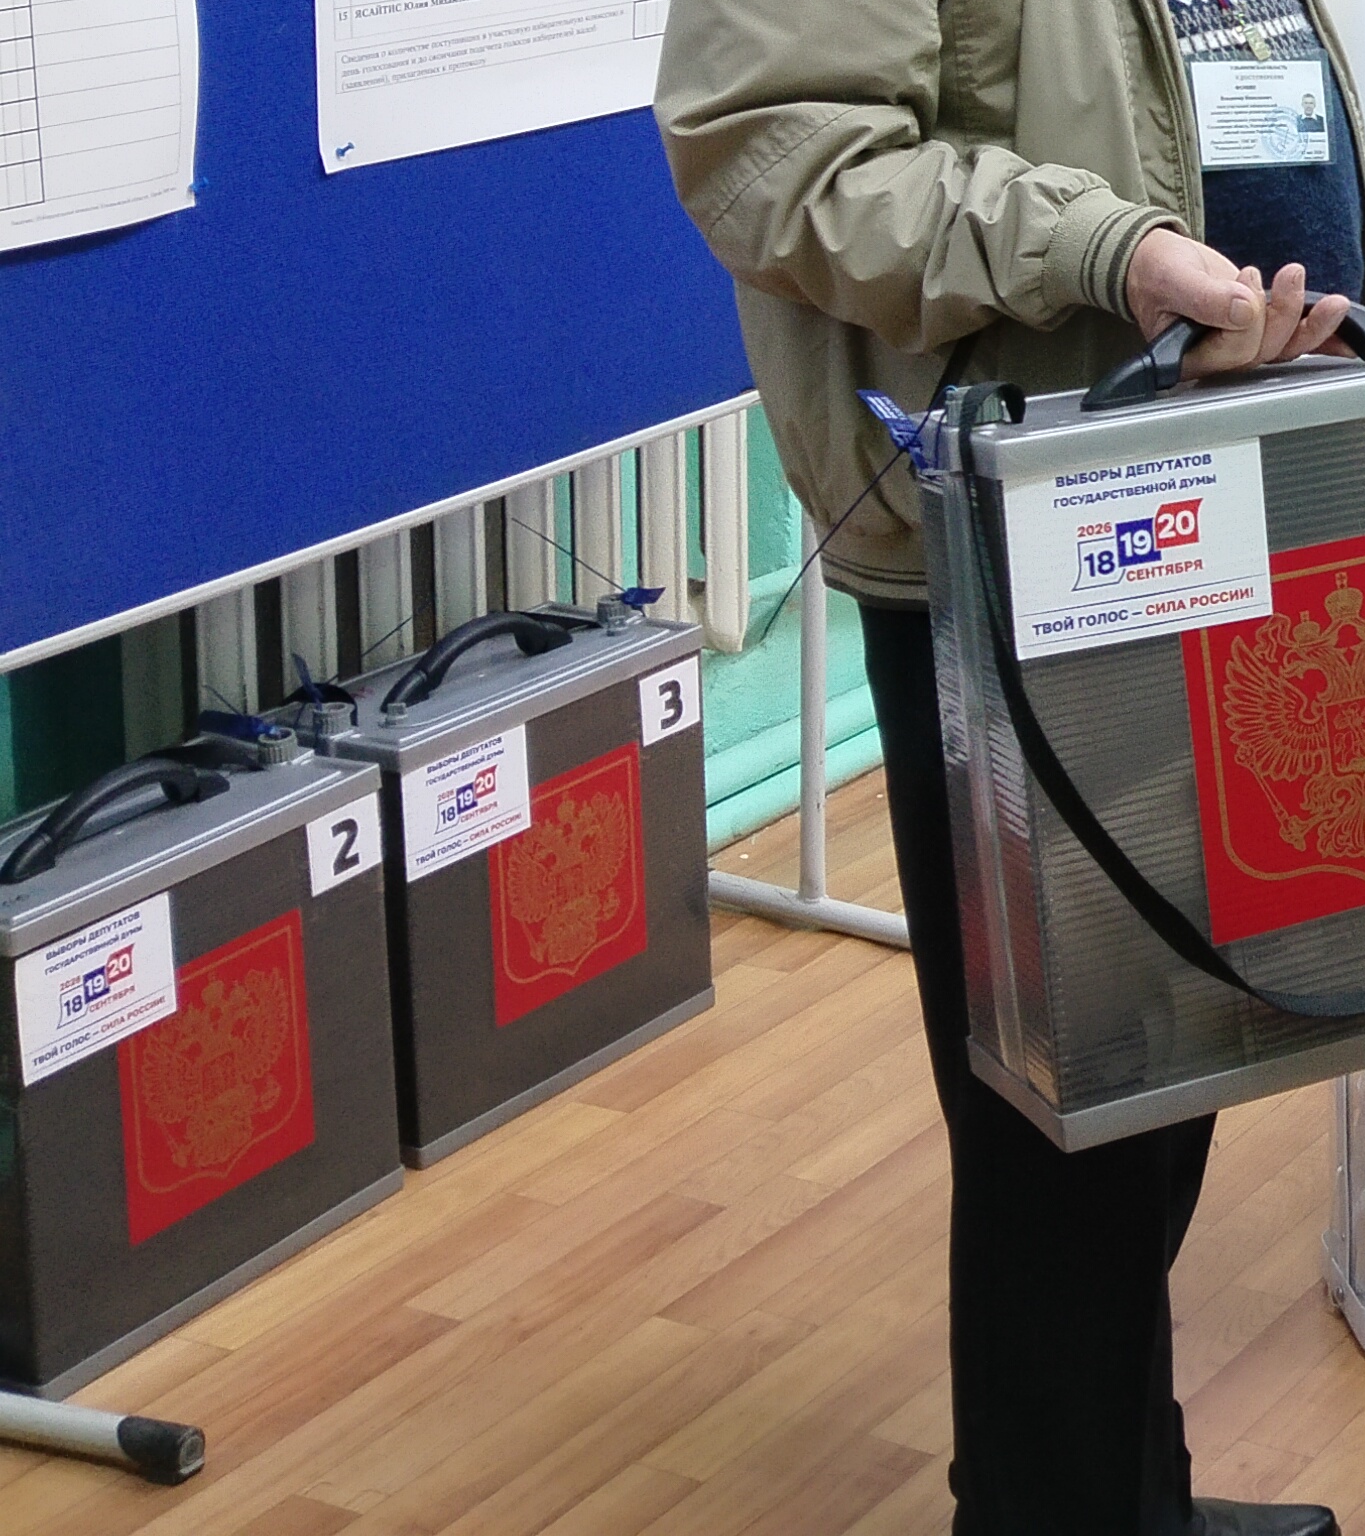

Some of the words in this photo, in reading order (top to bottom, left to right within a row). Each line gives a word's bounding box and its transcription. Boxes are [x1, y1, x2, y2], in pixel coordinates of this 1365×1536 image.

[338, 11, 348, 22] 15
[354, 3, 402, 19] ЯСАЙТИС
[404, 1, 429, 11] Юлия
[1053, 477, 1177, 509] ГОСУДАРСТВЕННОЙ
[1178, 474, 1217, 490] ДУМЫ
[1055, 467, 1122, 488] ВЫБОРЫ
[1125, 453, 1213, 479] ДЕПУТАТОВ
[1076, 521, 1113, 537] 2026
[1083, 550, 1116, 578] 18
[1119, 529, 1152, 558] 19
[1157, 510, 1196, 540] 20
[1126, 559, 1203, 583] СЕНТЯБРЯ
[1031, 616, 1074, 637] ТВОЙ
[1077, 609, 1129, 629] ГОЛОС
[1145, 600, 1186, 616] СИЛА
[1190, 587, 1254, 609] РОССИИ!
[658, 678, 684, 730] 3
[425, 755, 486, 787] ГОСУДАРСТВЕННОЙ
[486, 748, 505, 761] ДУМЫ
[427, 754, 459, 774] ВЫБОРЫ
[461, 736, 502, 760] ДЕПУТАТОВ
[441, 806, 456, 824] 18
[458, 789, 474, 807] 19
[475, 772, 494, 794] 20
[460, 801, 498, 823] СЕНТЯБРЯ
[330, 817, 360, 876] 2
[415, 850, 436, 865] ТВОЙ
[437, 839, 461, 855] ГОЛОС
[469, 828, 490, 841] СИЛА
[491, 812, 522, 831] РОССИИ!
[44, 934, 120, 976] ГОСУДАРСТВЕННОЙ
[121, 925, 143, 942] ДУМЫ
[46, 937, 87, 961] ВЫБОРЫ
[88, 911, 141, 943] ДЕПУТАТОВ
[63, 994, 84, 1017] 18
[85, 974, 105, 997] 19
[107, 953, 131, 979] 20
[89, 985, 136, 1013] СЕНТЯБРЯ
[33, 1046, 58, 1067] ТВОЙ
[60, 1031, 91, 1053] ГОЛОС
[101, 1016, 126, 1033] СИЛА
[127, 995, 166, 1020] РОССИИ!
